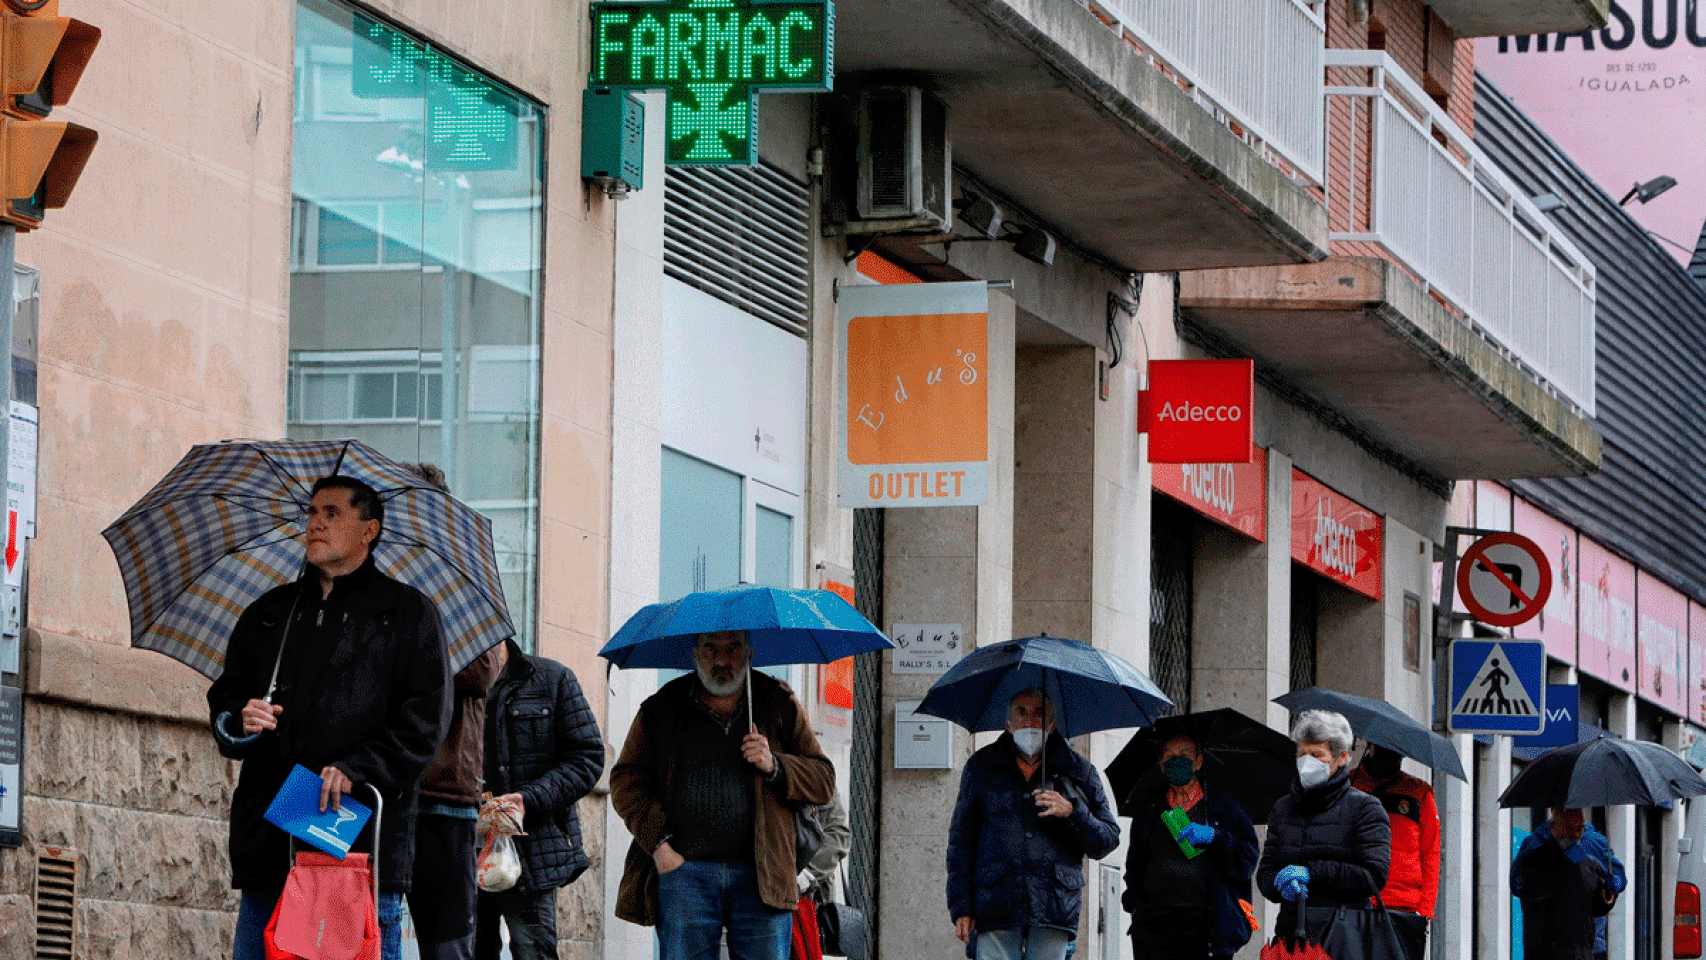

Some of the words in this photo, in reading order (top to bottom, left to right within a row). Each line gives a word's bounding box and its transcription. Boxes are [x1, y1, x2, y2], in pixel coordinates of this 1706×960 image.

[600, 11, 813, 79] FARMAC
[1579, 74, 1691, 92] IGUALADA
[1157, 401, 1242, 422] Adecco
[869, 471, 966, 500] OUTLET
[1314, 495, 1357, 579] Adecco
